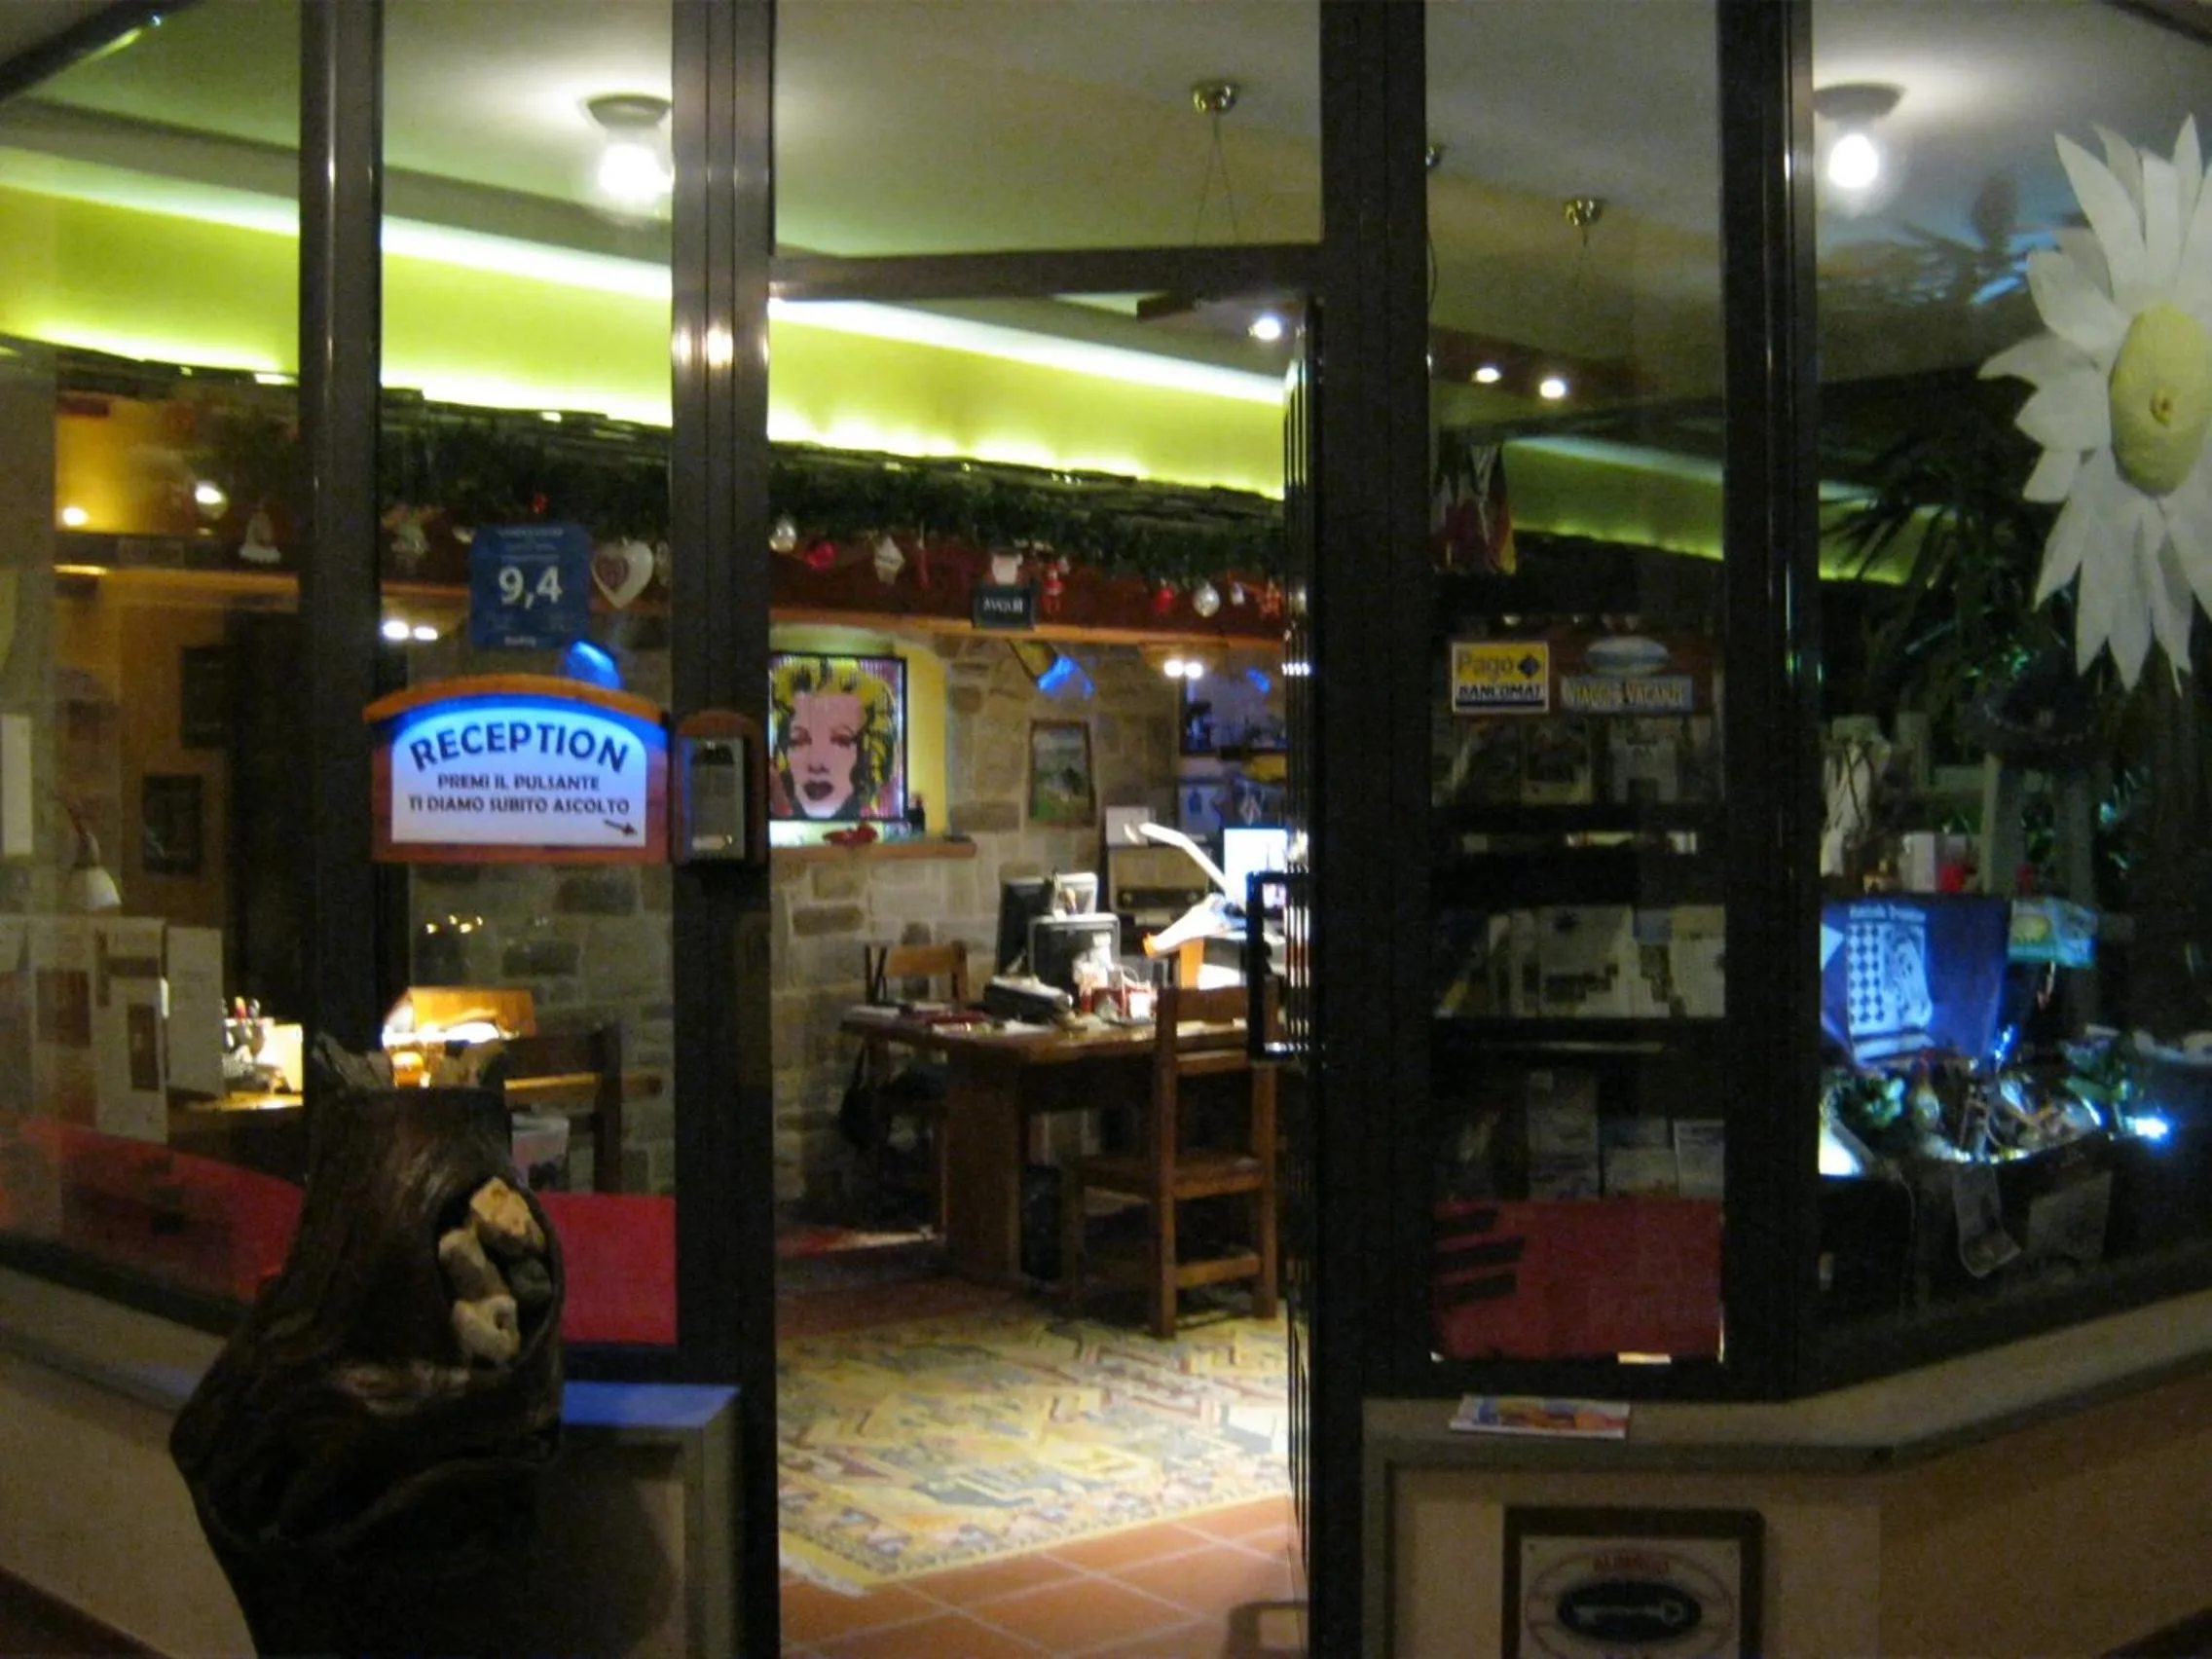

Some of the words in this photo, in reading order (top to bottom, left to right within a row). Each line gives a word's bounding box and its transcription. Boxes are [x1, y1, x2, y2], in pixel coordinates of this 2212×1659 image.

[498, 565, 563, 610] 9,4
[409, 720, 630, 773] RECEPTION
[438, 774, 489, 791] PREMI
[491, 775, 507, 791] IL
[514, 775, 601, 792] PULSANTE
[409, 795, 424, 812] TI
[428, 795, 485, 813] DIAMO
[490, 796, 548, 813] SUBITO
[553, 796, 630, 814] ASCOLTO
